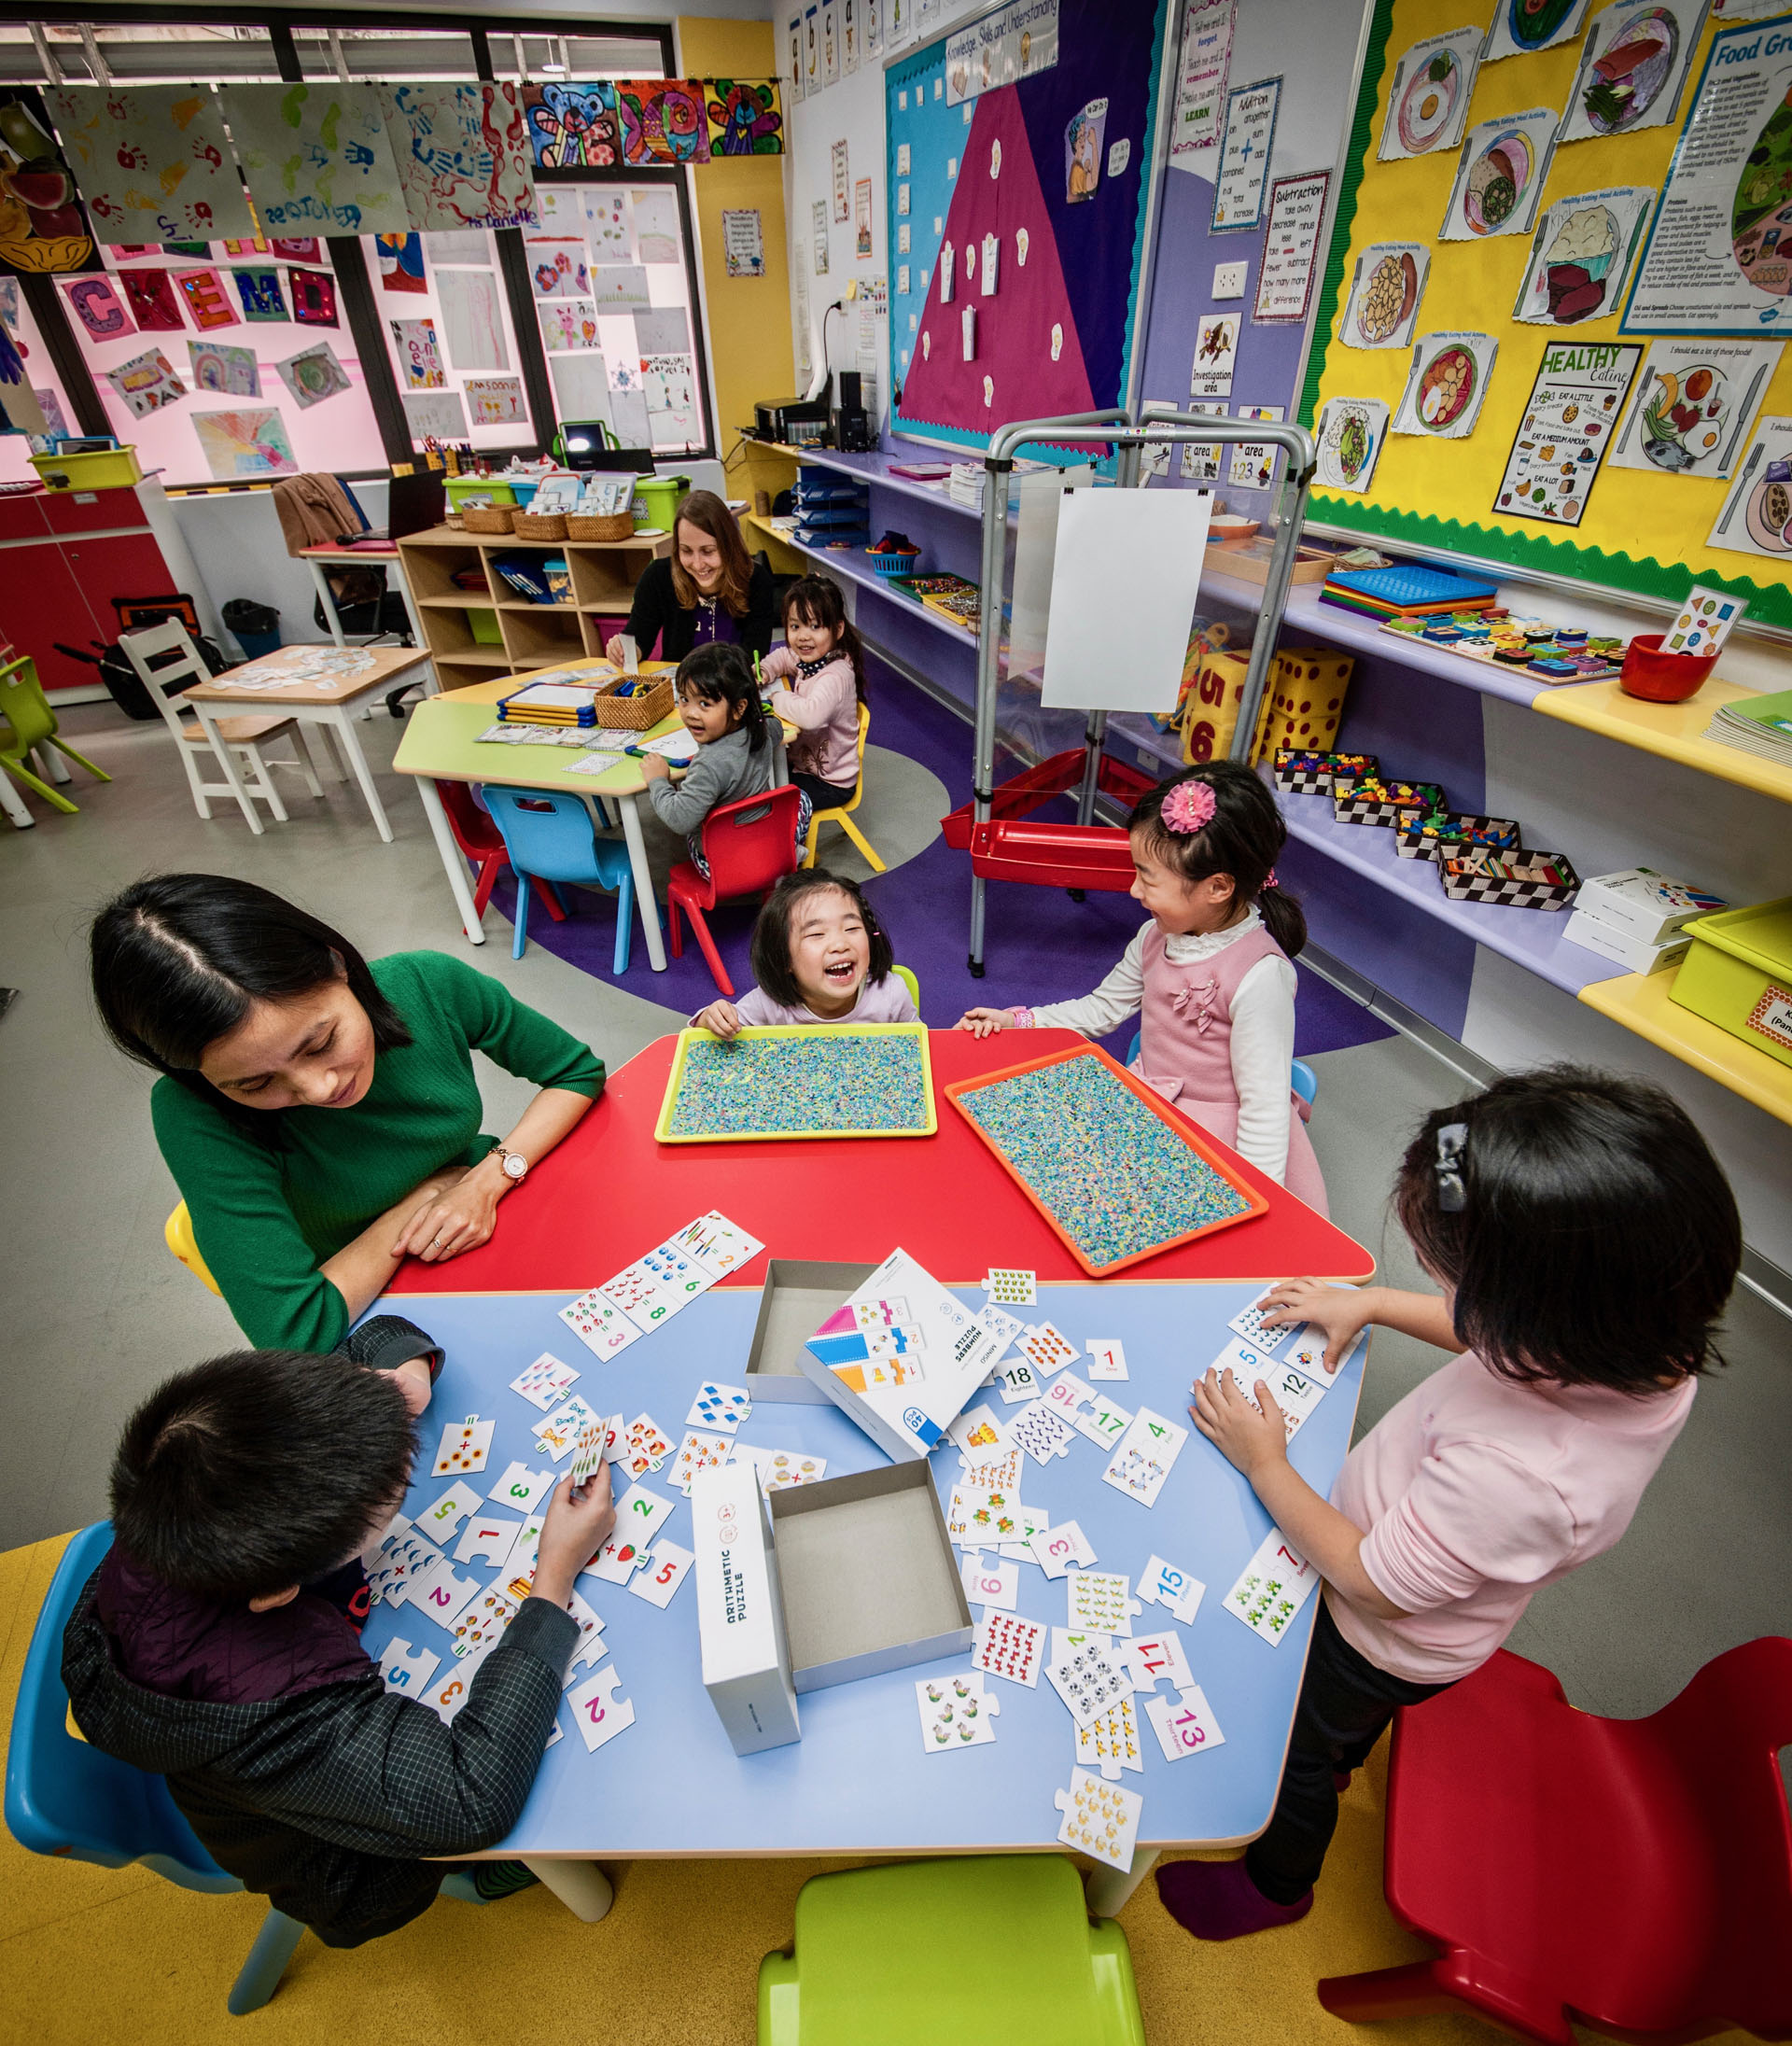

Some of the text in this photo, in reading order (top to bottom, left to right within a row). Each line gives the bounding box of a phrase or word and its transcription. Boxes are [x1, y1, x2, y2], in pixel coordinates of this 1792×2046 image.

[1197, 35, 1217, 47] forget
[1715, 36, 1763, 66] Food
[1186, 68, 1219, 84] remember
[1239, 94, 1268, 111] Addition
[1185, 106, 1210, 122] LEARN
[1253, 129, 1264, 139] sum
[1229, 146, 1239, 157] plus
[1254, 149, 1265, 159] add
[1223, 167, 1244, 178] combined
[1276, 186, 1323, 203] Subtraction
[1234, 208, 1253, 218] increase
[1296, 204, 1312, 214] away
[1272, 219, 1315, 231] decrease minus
[1281, 233, 1292, 243] less
[1266, 263, 1281, 273] fewer
[1287, 258, 1310, 267] subtract
[1264, 276, 1306, 287] how many more
[1273, 296, 1301, 304] difference
[1540, 345, 1623, 373] HEALTHY
[1193, 369, 1232, 384] Investigation
[1590, 362, 1630, 391] Eating
[1575, 394, 1595, 402] LITTLE
[1568, 438, 1589, 446] AMOUNT
[1194, 446, 1211, 456] area
[1244, 446, 1264, 457] area
[1533, 658, 1579, 670] 20
[1200, 668, 1225, 708] 5
[1190, 721, 1215, 763] 6
[718, 1254, 735, 1268] 2
[685, 1281, 701, 1292] 6
[651, 1307, 666, 1320] 8
[609, 1333, 625, 1347] 3
[954, 1324, 976, 1350] PUZZLE
[955, 1330, 982, 1362] NUMBERS
[980, 1344, 997, 1364] MINISO
[1103, 1351, 1114, 1366] 1
[1239, 1350, 1257, 1365] 5
[1005, 1367, 1031, 1385] 18
[1282, 1374, 1307, 1394] 12
[1011, 1383, 1036, 1393] Eighteen
[1051, 1385, 1074, 1406] 16
[912, 1415, 922, 1427] 40
[1099, 1412, 1125, 1432] 17
[1148, 1422, 1166, 1437] 4
[510, 1484, 530, 1498] 3
[434, 1501, 456, 1520] 5
[633, 1500, 653, 1517] 2
[479, 1530, 499, 1538] 1
[1049, 1539, 1070, 1556] 3
[1277, 1545, 1298, 1566] 7
[656, 1563, 677, 1584] 5
[1156, 1566, 1183, 1597] 15
[721, 1549, 736, 1624] ARITHMETIC
[428, 1587, 451, 1606] 2
[735, 1573, 748, 1621] PUZZLE
[1138, 1643, 1165, 1675] 11
[387, 1666, 411, 1688] 5
[440, 1681, 463, 1705] 3
[584, 1696, 606, 1723] 2
[1175, 1709, 1206, 1747] 13
[1165, 1718, 1184, 1755] Thirteen
